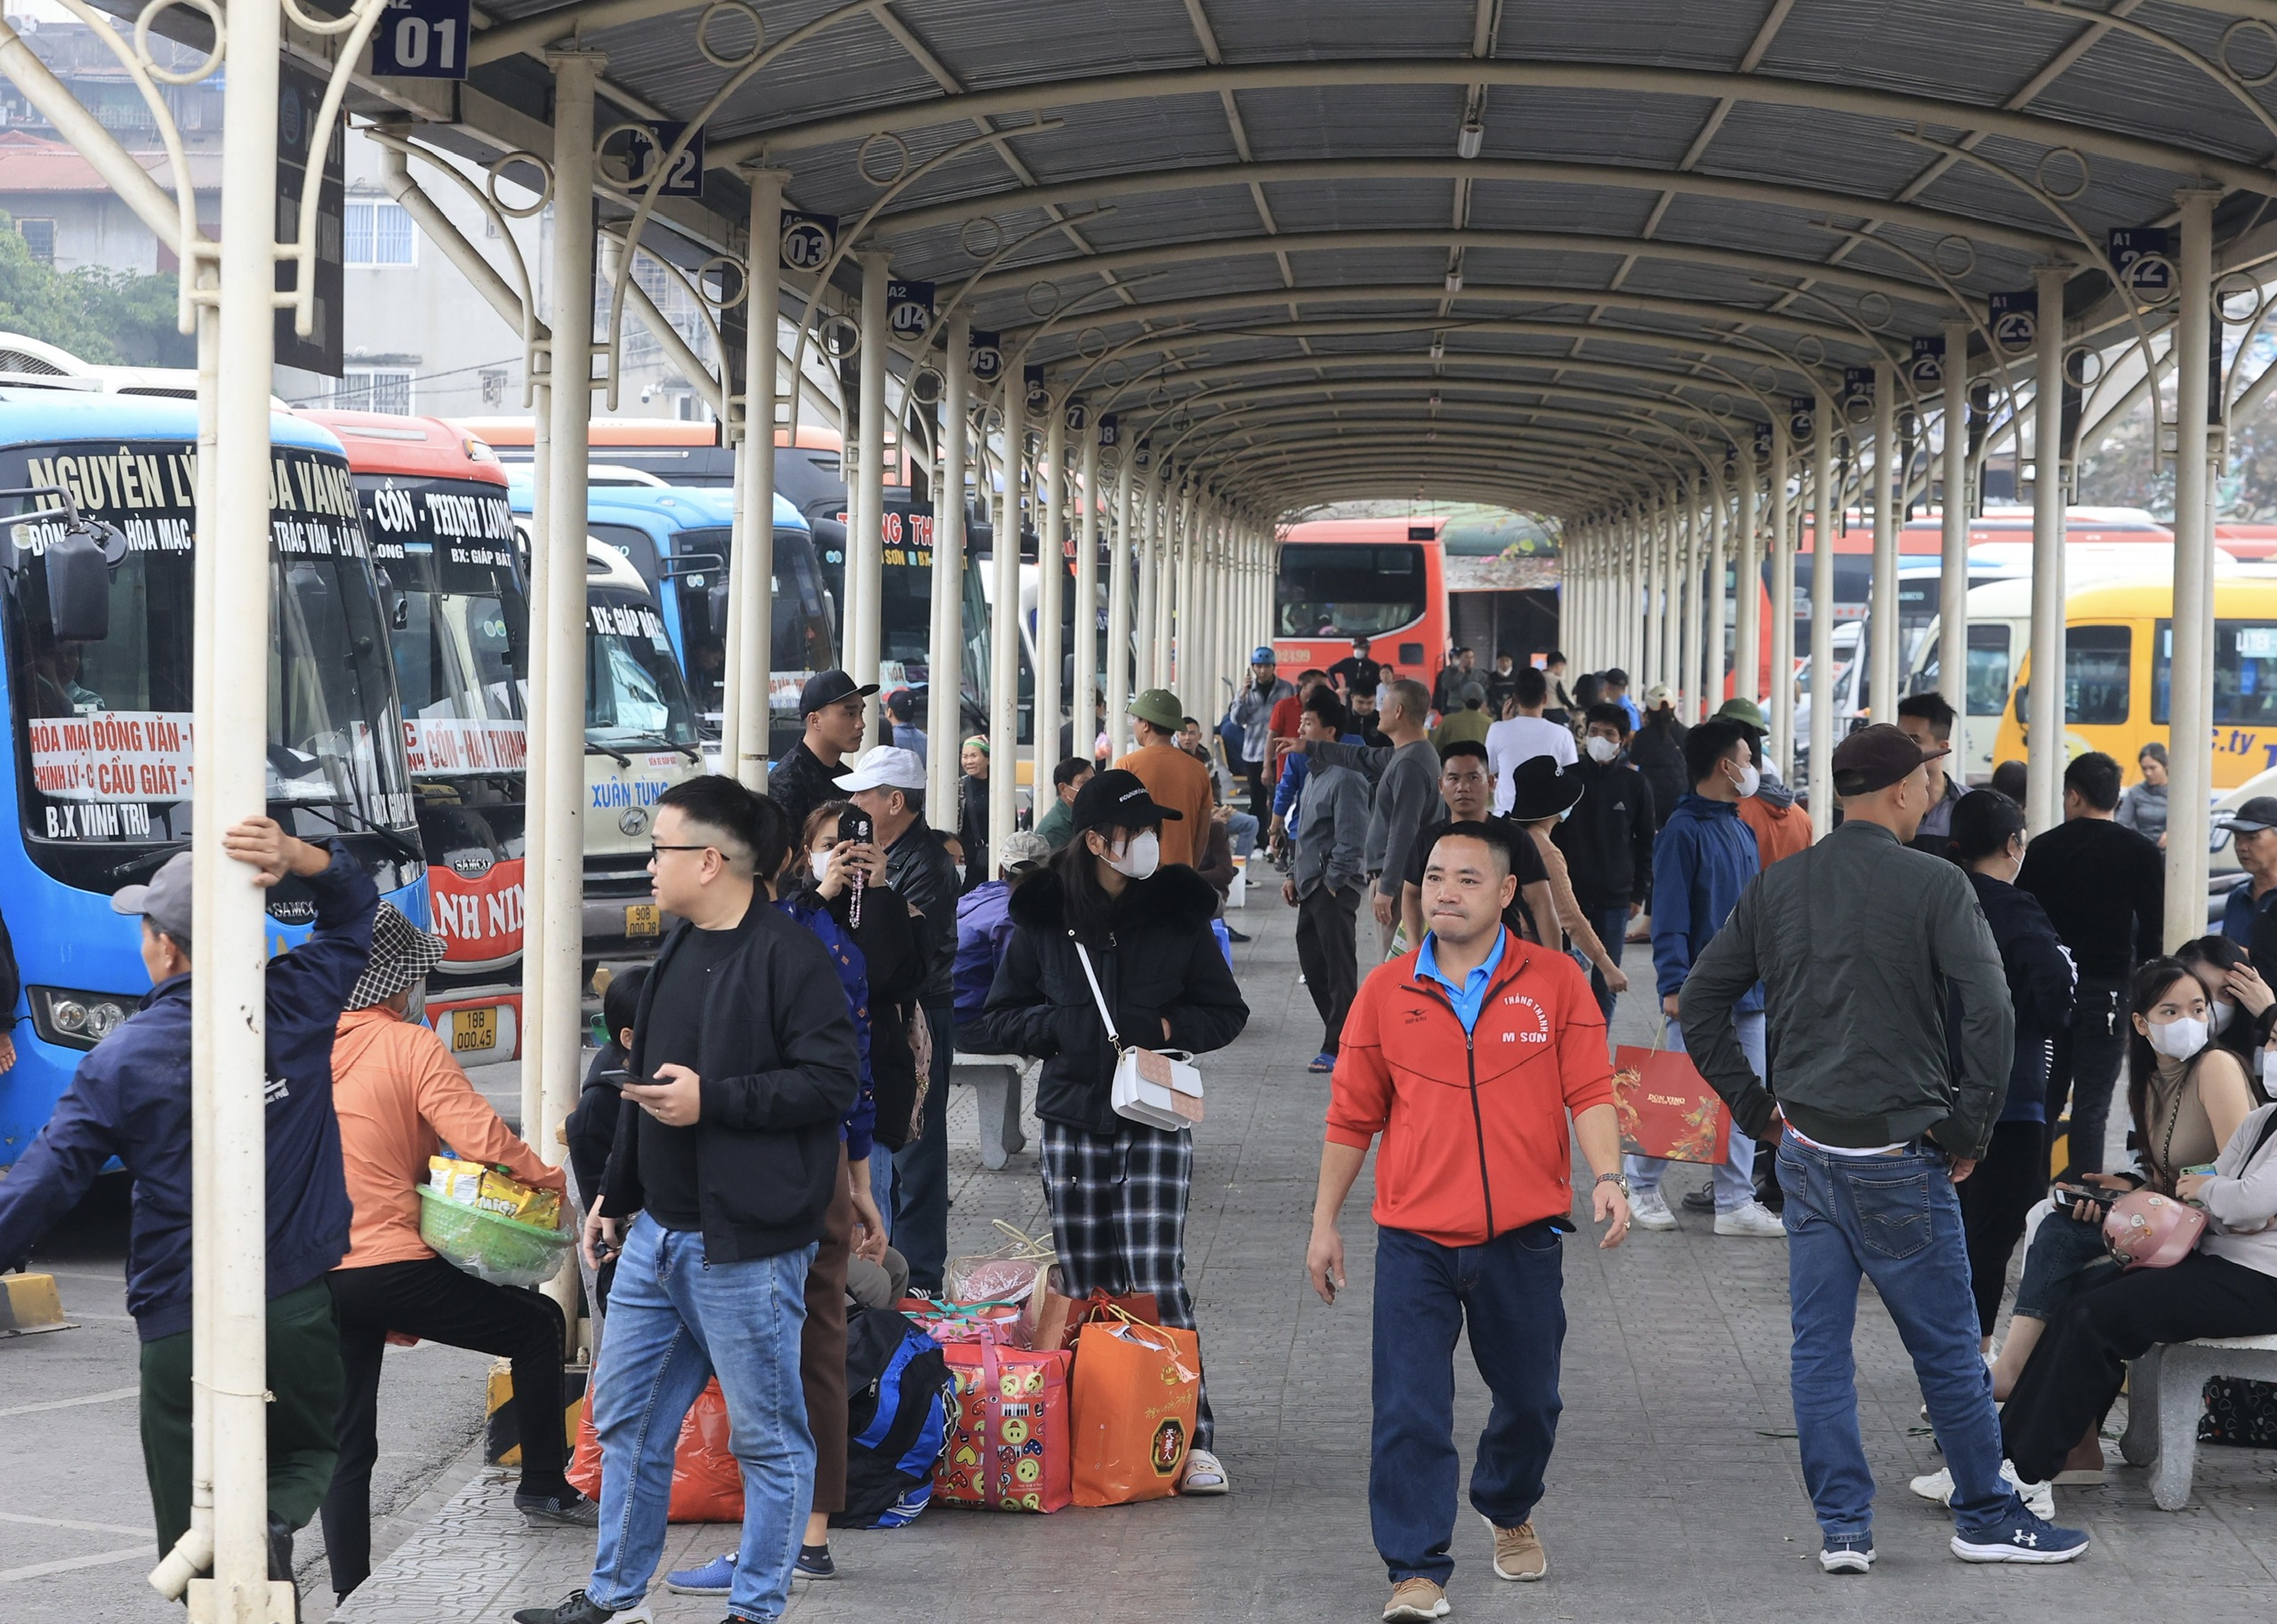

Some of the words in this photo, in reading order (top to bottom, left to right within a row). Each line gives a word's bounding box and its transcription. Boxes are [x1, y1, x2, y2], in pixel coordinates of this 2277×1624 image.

[395, 17, 455, 68] 01
[787, 234, 827, 265] 03
[2112, 232, 2131, 245] A1
[888, 285, 907, 298] A2
[1992, 296, 2007, 308] A1
[1915, 340, 1928, 350] A1
[1847, 370, 1860, 380] A1
[28, 446, 166, 511] NGUYÊN
[167, 446, 197, 507] LÝ
[294, 454, 356, 519] VÀNG
[374, 478, 416, 532] CỒN
[425, 493, 481, 544] THỊNH
[479, 497, 516, 542] LONG
[125, 513, 157, 551] HÒA
[157, 510, 191, 556] MẠC
[273, 516, 307, 553] TRÁC
[305, 518, 332, 555] VĂN
[450, 548, 470, 563] BX:
[471, 547, 494, 565] GIÁP
[495, 549, 512, 567] BÁT
[591, 607, 616, 634] BX:
[613, 604, 640, 637] GIÁP
[637, 607, 662, 639] BÁT
[29, 720, 60, 753] HÒA
[93, 712, 143, 752] ĐỒNG
[145, 715, 181, 752] VĂN
[33, 760, 67, 791] CHÍNH
[67, 759, 81, 789] LÝ
[98, 755, 136, 794] CẦU
[140, 759, 178, 794] GIÁT
[591, 775, 632, 808] XUÂN
[78, 798, 119, 836] VĨNH
[120, 803, 150, 839] TRỤ
[467, 1013, 485, 1028] 18B
[1533, 1003, 1549, 1032] THANH
[457, 1030, 492, 1049] 000.45
[1520, 1032, 1547, 1042] SƠN
